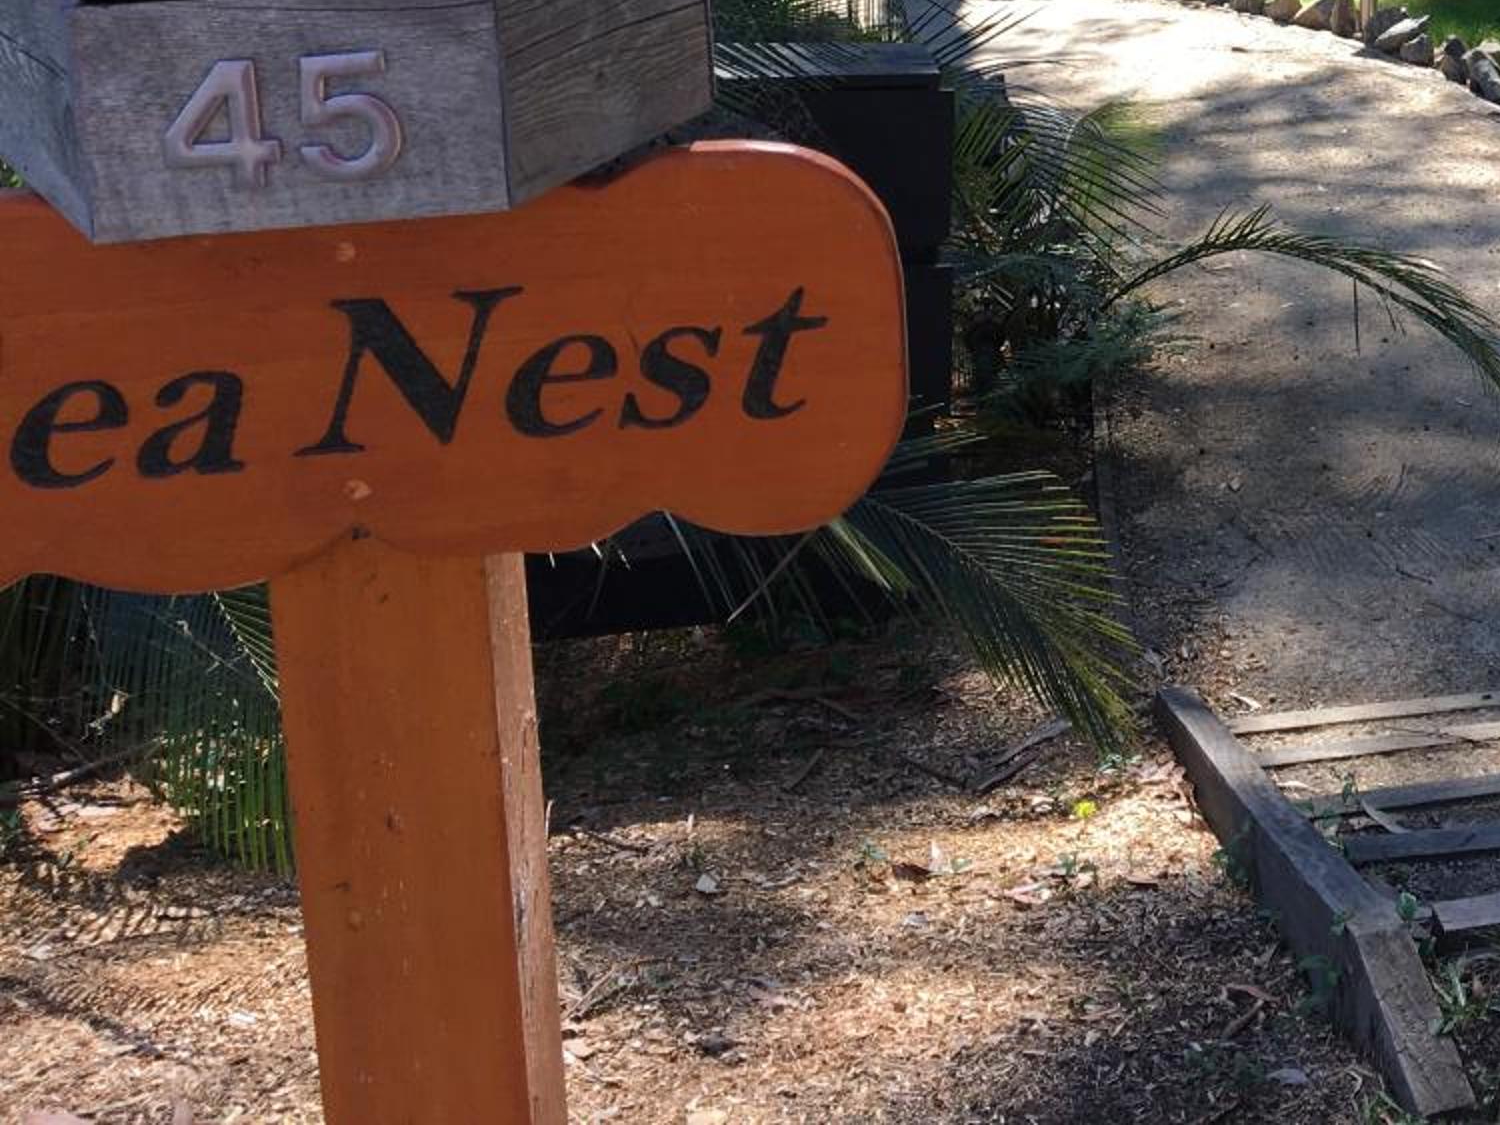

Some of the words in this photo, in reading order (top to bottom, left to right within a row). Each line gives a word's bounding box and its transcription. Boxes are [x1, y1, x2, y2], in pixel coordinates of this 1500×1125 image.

[163, 50, 403, 187] 45
[0, 330, 245, 489] ea
[294, 286, 829, 458] Nest
